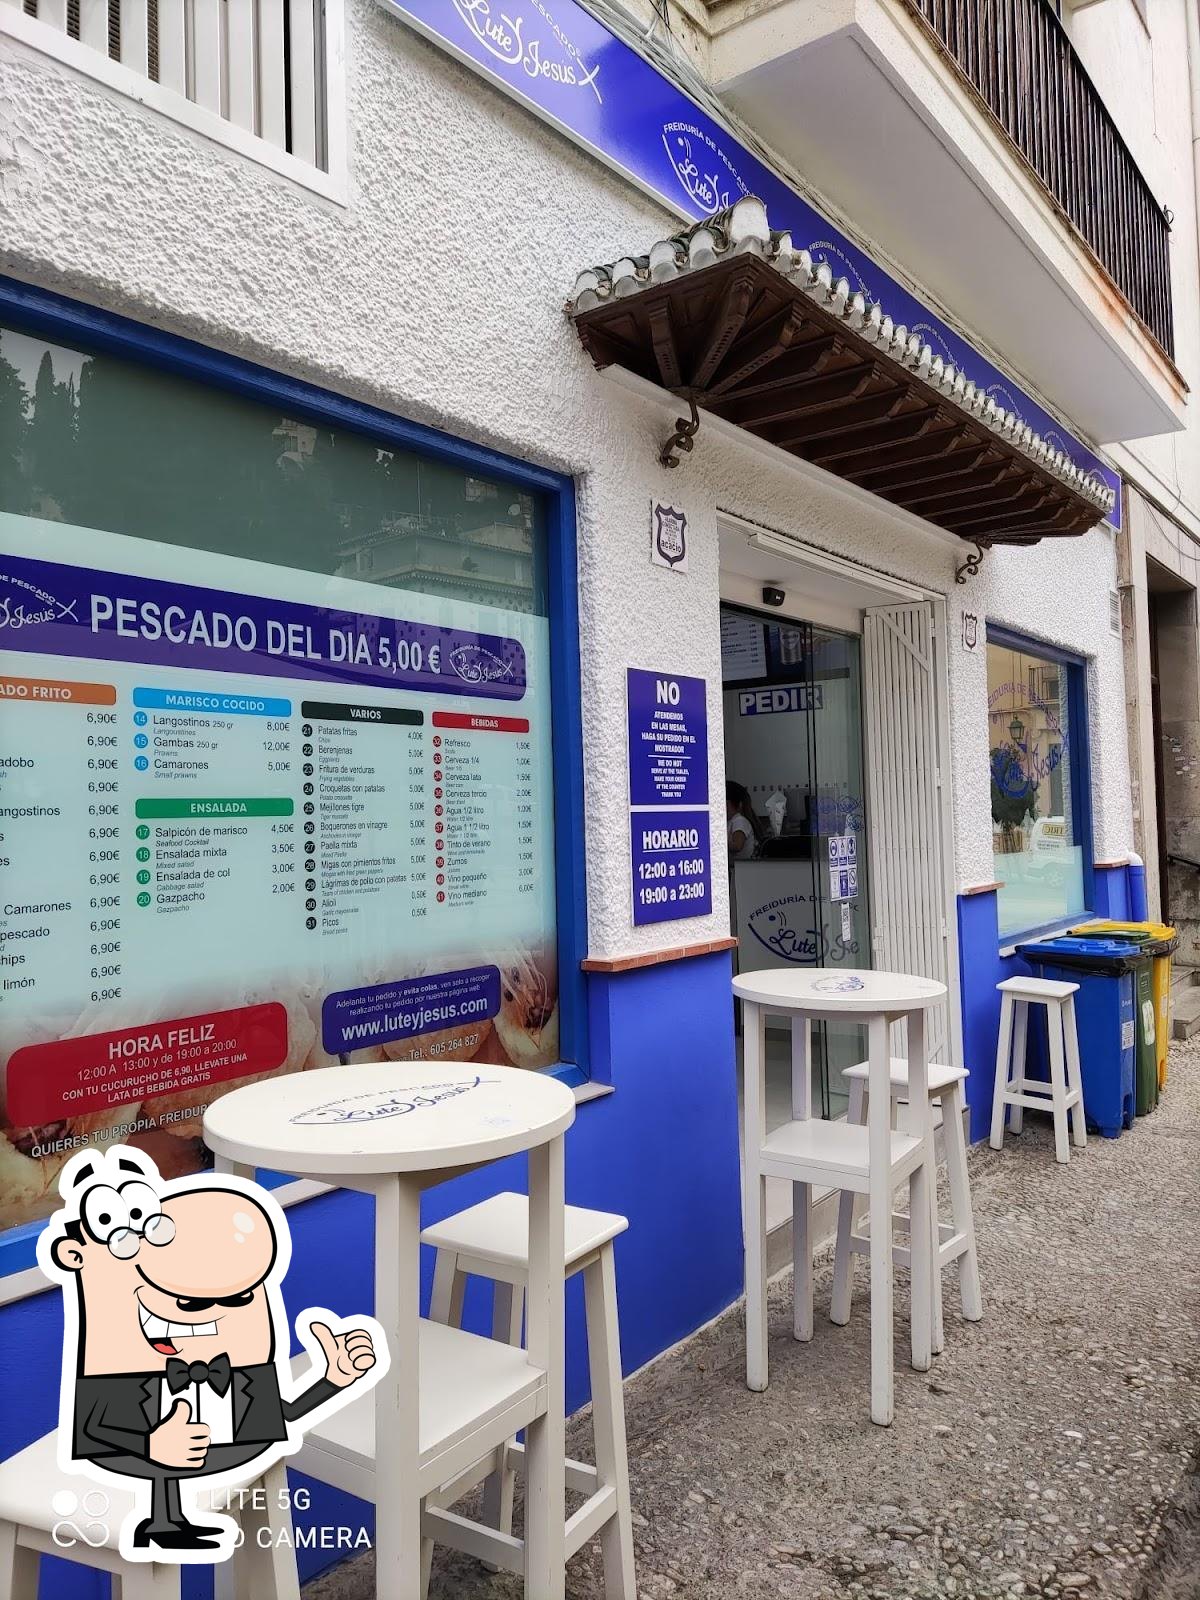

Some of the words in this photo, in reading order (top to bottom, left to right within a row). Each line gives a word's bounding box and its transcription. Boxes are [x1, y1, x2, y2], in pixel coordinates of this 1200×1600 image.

[705, 137, 716, 151] DE
[679, 159, 712, 204] Lute
[11, 578, 55, 602] PESCADO
[90, 594, 256, 651] PESCADO
[267, 620, 321, 659] DEL
[330, 629, 371, 665] DIA
[378, 636, 422, 674] 5,00
[33, 685, 71, 699] FRITO
[657, 680, 680, 705] NO
[166, 695, 219, 708] MARISCO
[223, 699, 264, 711] COCIDO
[741, 686, 821, 714] PEDIR
[87, 713, 117, 724] 6,90€
[350, 708, 381, 719] VARIOS
[153, 716, 210, 729] Langostinos
[267, 722, 290, 732] 8,00€
[471, 719, 498, 727] BEBIDAS
[87, 736, 117, 747] 6,90€
[154, 738, 194, 748] Gambas
[263, 742, 290, 752] 12,00€
[88, 759, 118, 770] 6,90€
[154, 760, 208, 769] Camarones
[268, 761, 291, 771] 5,00€
[88, 782, 119, 793] 6,90€
[320, 784, 351, 793] Croquetas
[89, 805, 119, 816] 6,90€
[191, 803, 247, 813] ENSALADA
[89, 828, 120, 839] 6,90€
[156, 827, 195, 838] Salpicón
[199, 826, 209, 836] de
[213, 826, 247, 835] marisco
[271, 824, 293, 834] 4,50€
[321, 822, 356, 831] Boquerones
[367, 821, 387, 830] vinagre
[643, 829, 698, 850] HORARIO
[90, 851, 120, 862] 6,90€
[156, 849, 200, 860] Ensalada
[203, 848, 227, 857] mixta
[272, 844, 294, 854] 3,50€
[157, 870, 200, 882] Ensalada
[203, 869, 214, 878] de
[217, 868, 230, 878] col
[272, 863, 294, 874] 3,00€
[639, 863, 666, 879] 12:00
[669, 866, 675, 877] a
[678, 859, 703, 875] 16:00
[90, 873, 120, 885] 6,90€
[157, 892, 205, 906] Gazpacho
[273, 883, 294, 894] 2,00€
[640, 887, 667, 904] 19:00
[670, 891, 676, 901] a
[679, 883, 704, 900] 23:00
[4, 901, 71, 916] Camarones
[90, 896, 120, 908] 6,90€
[749, 894, 806, 920] FREIDURÍA
[90, 919, 120, 931] 6,90€
[0, 926, 50, 942] pescado
[91, 942, 120, 954] 6,90€
[769, 929, 817, 955] Lute
[91, 965, 121, 978] 6,90€
[4, 977, 35, 990] limón
[91, 988, 121, 1001] 6,90€
[336, 997, 365, 1009] Adelanta
[376, 991, 396, 1001] pedido
[404, 987, 419, 995] evita
[470, 974, 490, 984] recoger
[350, 1004, 383, 1015] realizando
[393, 998, 413, 1008] pedido
[415, 996, 425, 1004] por
[426, 991, 447, 1000] nuestra
[342, 997, 487, 1040] www.luteyjesus.com
[109, 1036, 162, 1059] HORA
[168, 1024, 214, 1047] FELIZ
[410, 1047, 427, 1060] Tel.:
[431, 1044, 445, 1055] 605
[448, 1039, 462, 1051] 264
[465, 1035, 479, 1045] 827
[78, 1066, 106, 1081] 12:00
[109, 1064, 116, 1075] A
[123, 1059, 149, 1071] 13:00
[153, 1059, 158, 1068] y
[161, 1053, 172, 1064] de
[177, 1047, 201, 1059] 19:00
[213, 1039, 236, 1052] 20:00
[63, 1090, 83, 1101] CON
[86, 1086, 98, 1095] TU
[101, 1073, 158, 1092] CUCURUCHO
[161, 1070, 172, 1079] DE
[195, 1057, 228, 1072] LLEVATE
[231, 1054, 247, 1064] UNA
[108, 1091, 130, 1103] LATA
[133, 1088, 144, 1097] DE
[147, 1081, 178, 1094] BEBIDA
[180, 1072, 210, 1087] GRATIS
[32, 1134, 88, 1158] QUIERES
[92, 1129, 108, 1141] TU
[112, 1116, 156, 1137] PROPIA
